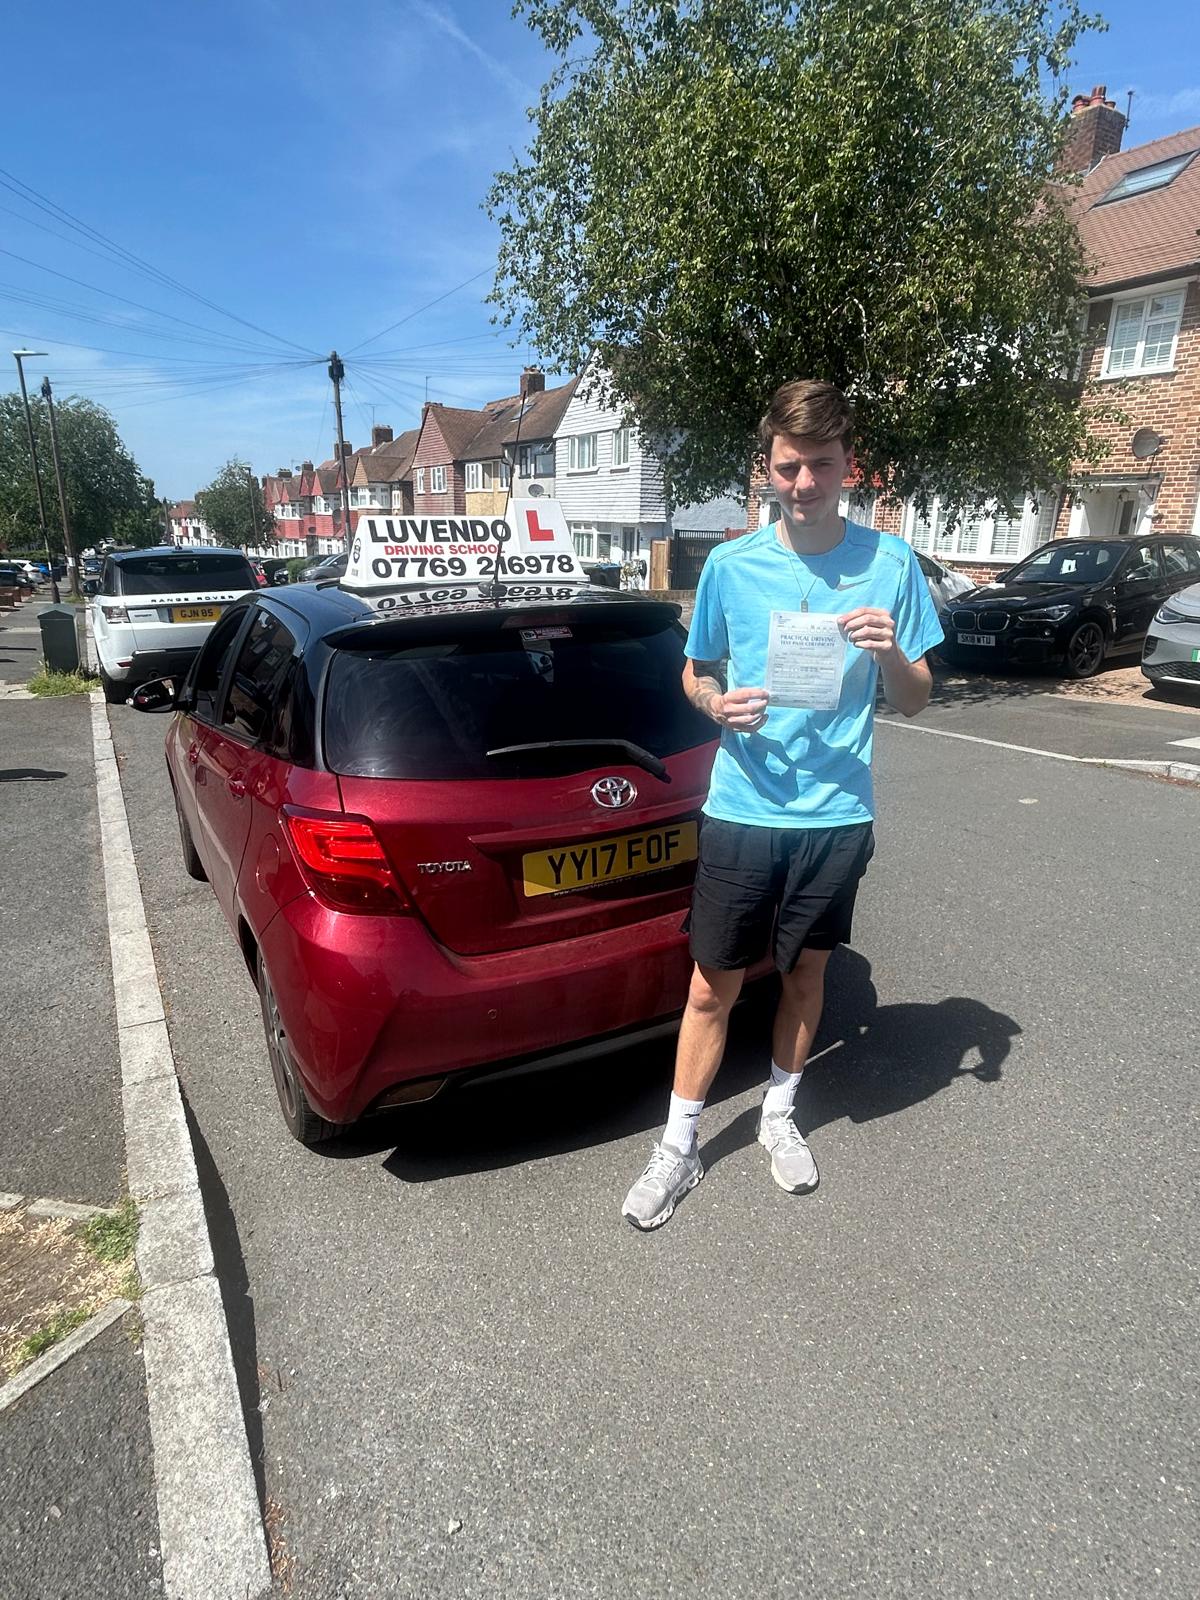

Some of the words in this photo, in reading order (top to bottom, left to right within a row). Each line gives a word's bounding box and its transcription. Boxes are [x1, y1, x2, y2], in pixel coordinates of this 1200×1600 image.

[367, 519, 512, 543] LUVENDO
[525, 510, 555, 542] L
[384, 545, 445, 556] DRIVING
[371, 557, 467, 579] 07769
[476, 555, 575, 576] 216978
[180, 608, 200, 618] GJN
[780, 634, 810, 642] PRACTICAL
[810, 635, 836, 643] DRIVING
[547, 844, 618, 885] YY17
[627, 829, 681, 870] FOF
[416, 860, 473, 874] TOYOTA
